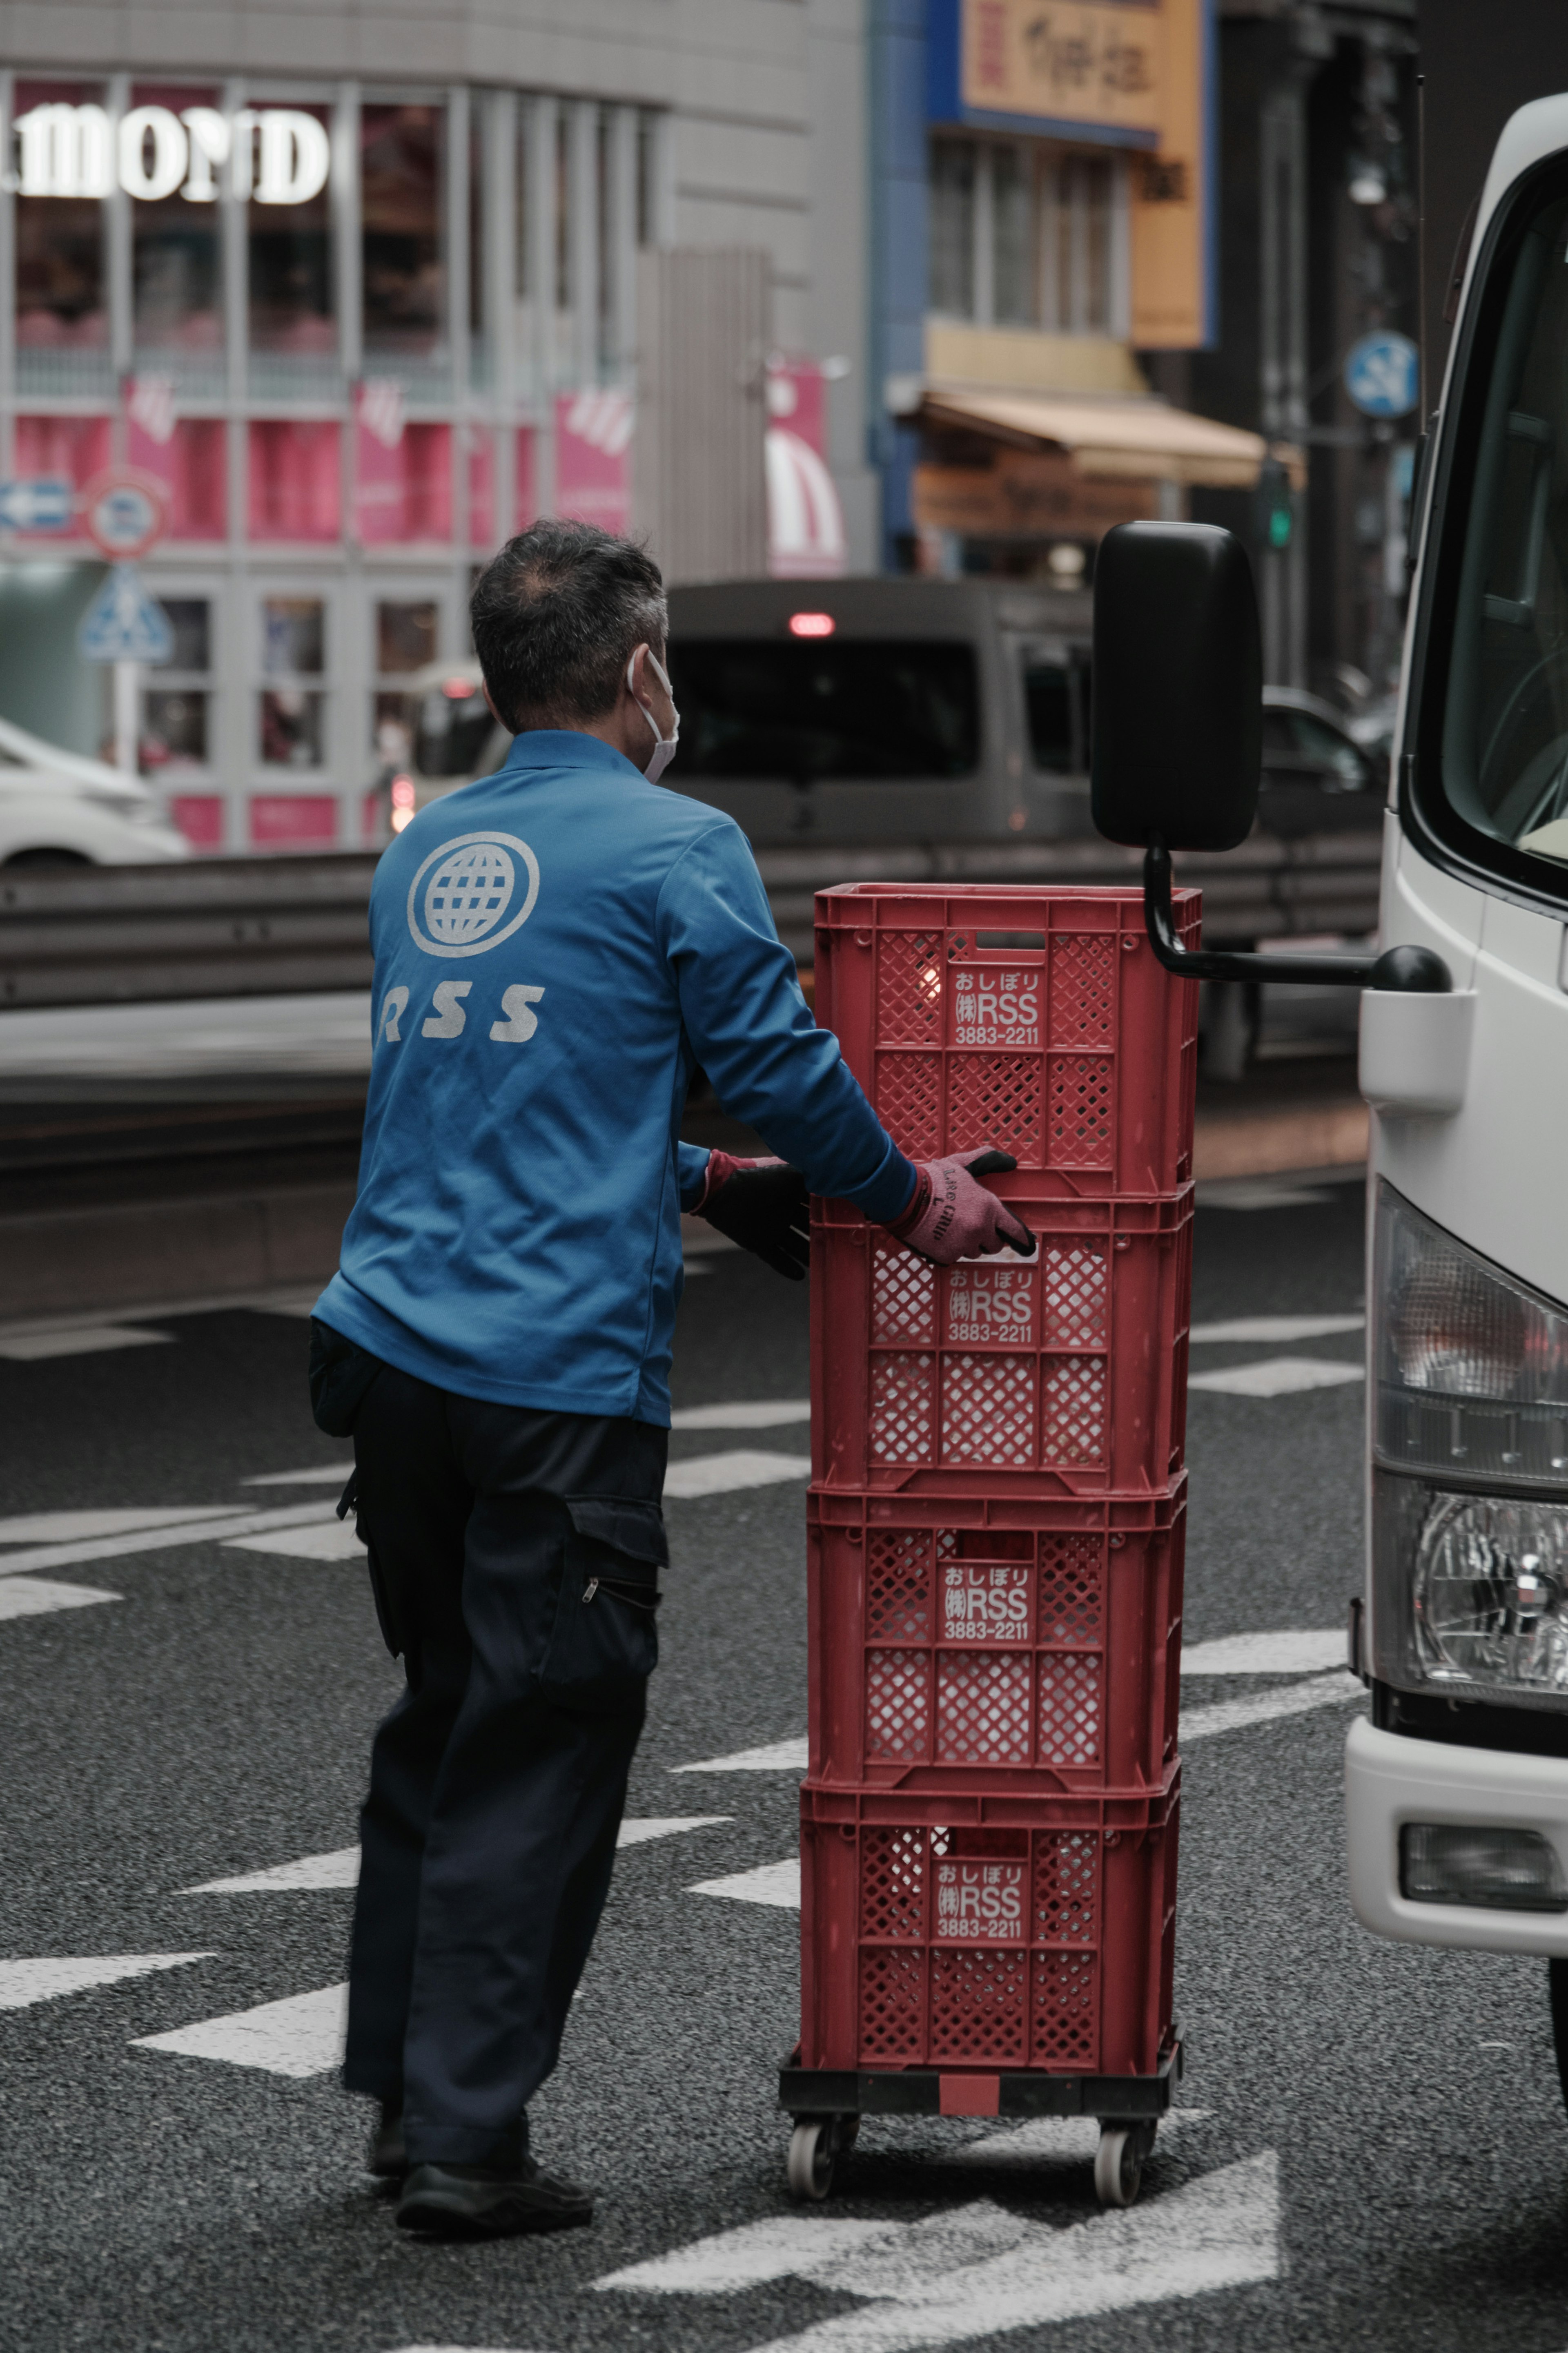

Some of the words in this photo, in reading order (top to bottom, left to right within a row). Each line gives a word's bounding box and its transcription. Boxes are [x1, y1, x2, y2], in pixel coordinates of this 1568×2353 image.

[956, 972, 1038, 991] おしぼり
[375, 981, 546, 1044] RSS
[956, 1027, 1038, 1044] 3883-2211
[950, 1270, 1032, 1289] おしぼり
[949, 1323, 1031, 1343] 3883-2211
[945, 1567, 1028, 1586] おしぼり
[945, 1621, 1028, 1640] 3883-2211
[938, 1865, 1021, 1885] おしぼり
[938, 1918, 1020, 1938] 3883-2211
